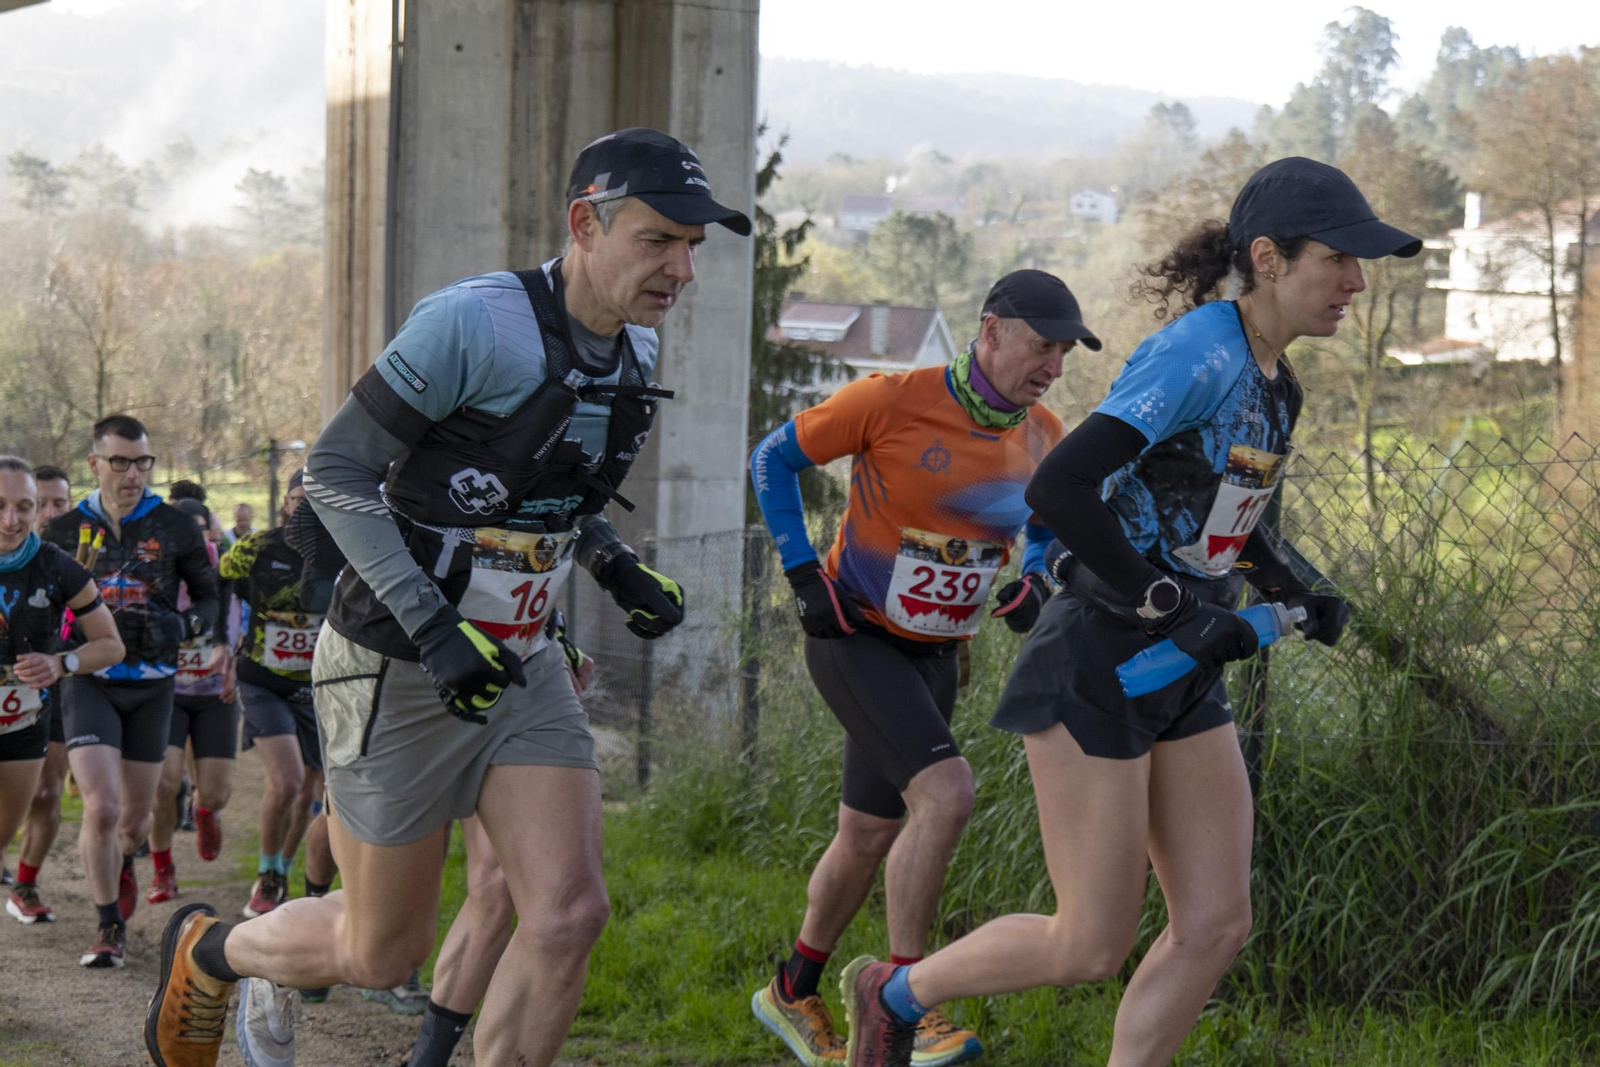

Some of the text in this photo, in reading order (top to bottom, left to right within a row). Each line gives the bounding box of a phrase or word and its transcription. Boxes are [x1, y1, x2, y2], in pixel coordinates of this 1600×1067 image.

[532, 416, 572, 460] TRANSVULCANIA
[755, 427, 788, 493] RUNMANIAK
[510, 577, 551, 621] 16
[908, 565, 981, 602] 239
